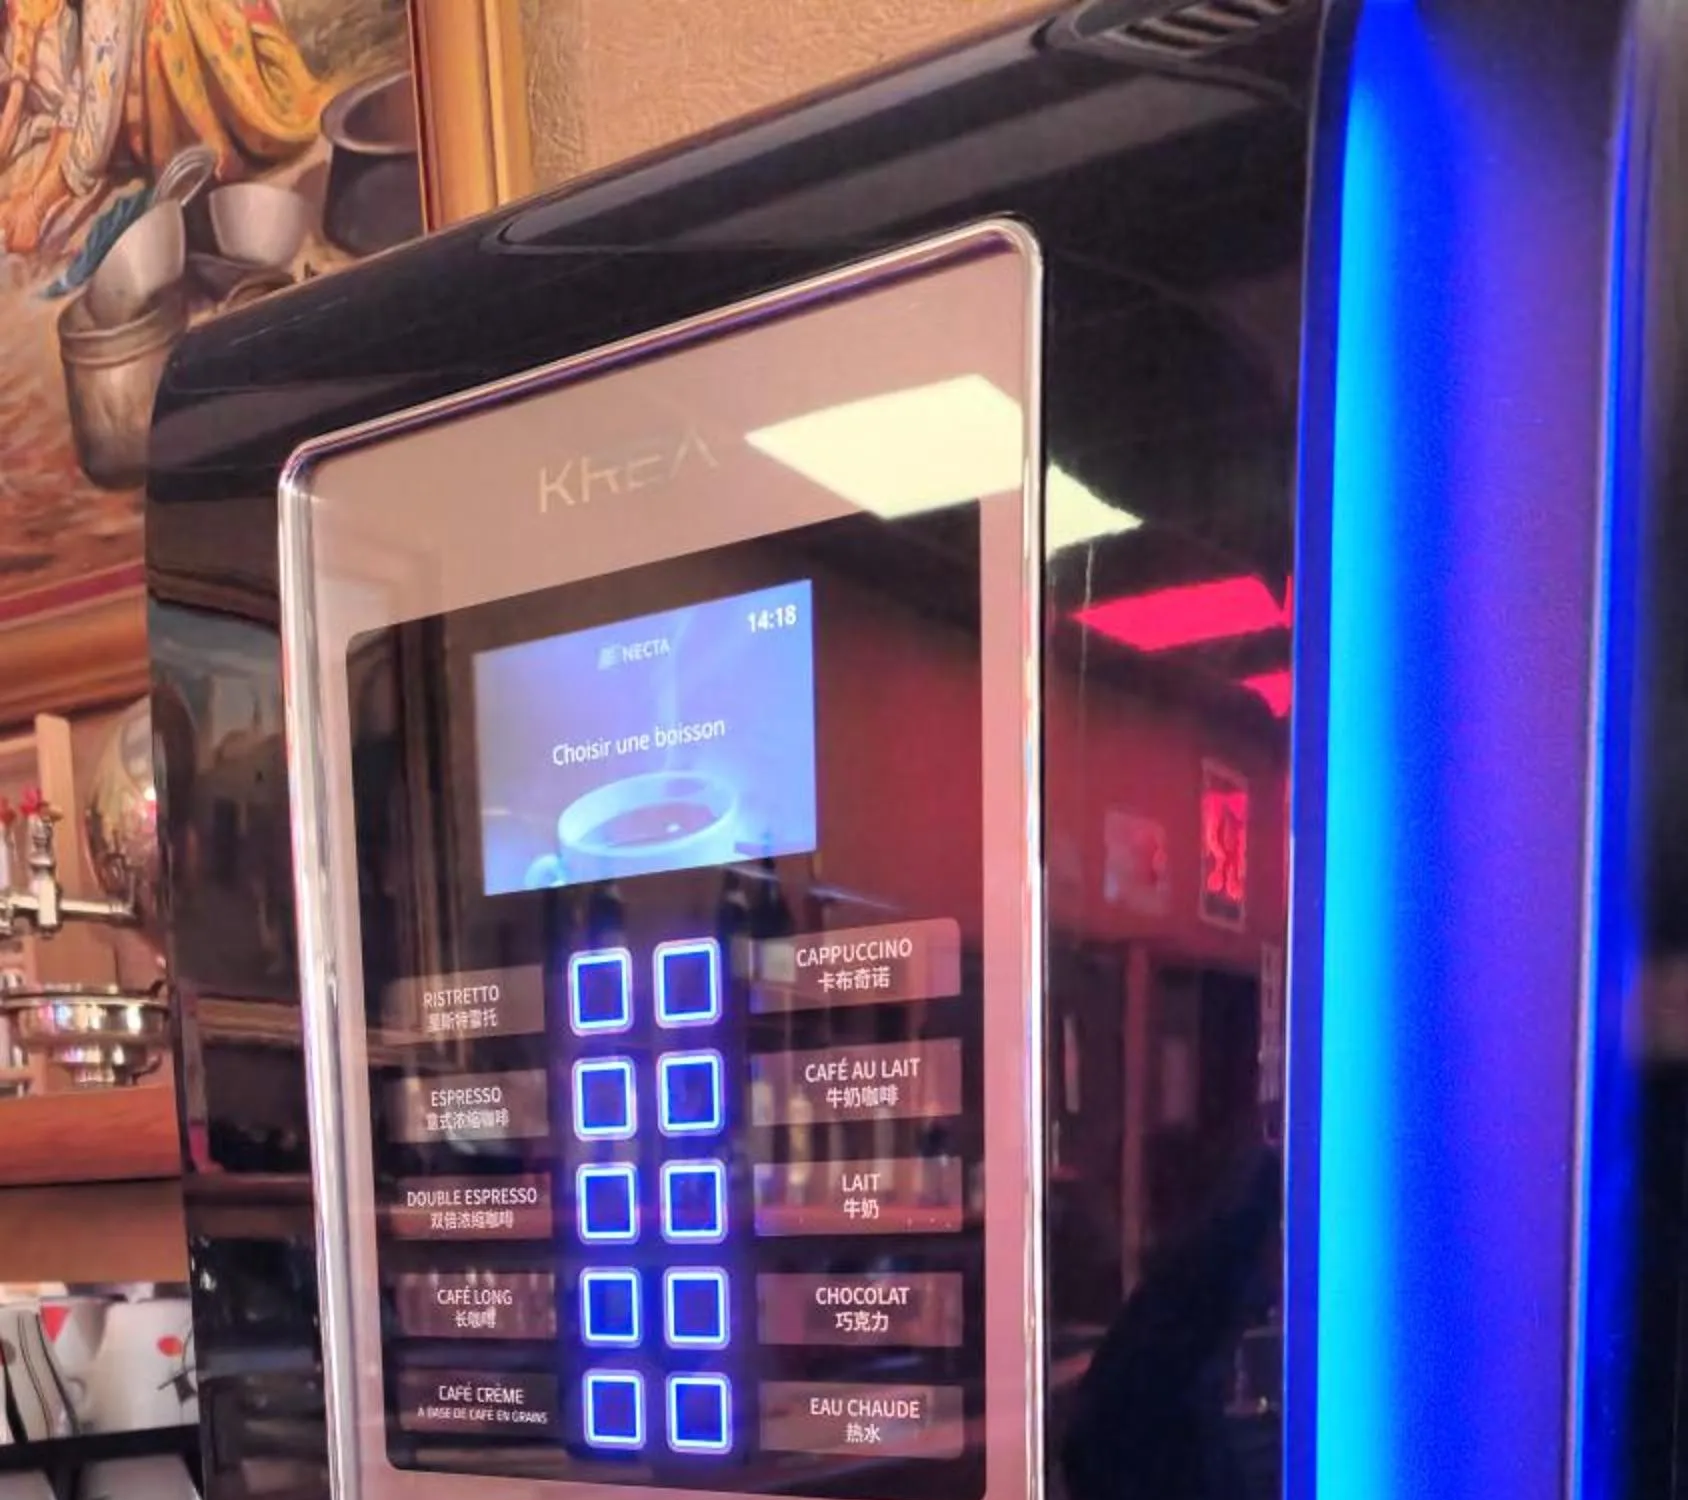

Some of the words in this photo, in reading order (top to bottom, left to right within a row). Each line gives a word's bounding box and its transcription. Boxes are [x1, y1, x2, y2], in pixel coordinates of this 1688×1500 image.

[747, 604, 797, 633] 14:18
[622, 638, 670, 663] NECTA
[553, 738, 612, 767] Choisir
[616, 732, 650, 755] une
[655, 719, 726, 749] boisson
[796, 937, 913, 968] CAPPUCCINO
[817, 966, 891, 993] 卡布奇诺
[423, 985, 500, 1009] RISTRETTO
[805, 1056, 848, 1083] CAFÉ
[851, 1060, 876, 1079] AU
[881, 1057, 921, 1078] LAIT
[431, 1086, 502, 1108] ESPRESSO
[825, 1083, 899, 1109] 牛奶咖啡
[842, 1174, 881, 1193] LAIT
[407, 1190, 462, 1207] DOUBLE
[465, 1187, 537, 1205] ESPRESSO
[843, 1199, 879, 1220] 牛奶
[437, 1285, 471, 1305] CAFÉ
[474, 1290, 513, 1305] LONG
[815, 1287, 910, 1305] CHOCOLAT
[835, 1311, 889, 1333] 巧克力
[438, 1382, 473, 1402] CAFÉ
[476, 1383, 525, 1405] CRÈME
[427, 1406, 451, 1420] BASE
[453, 1407, 467, 1420] DE
[496, 1410, 511, 1422] EN
[512, 1410, 549, 1425] GRAINS
[810, 1398, 843, 1417] EAU
[847, 1399, 921, 1419] CHAUDE
[846, 1422, 882, 1444] 热水
